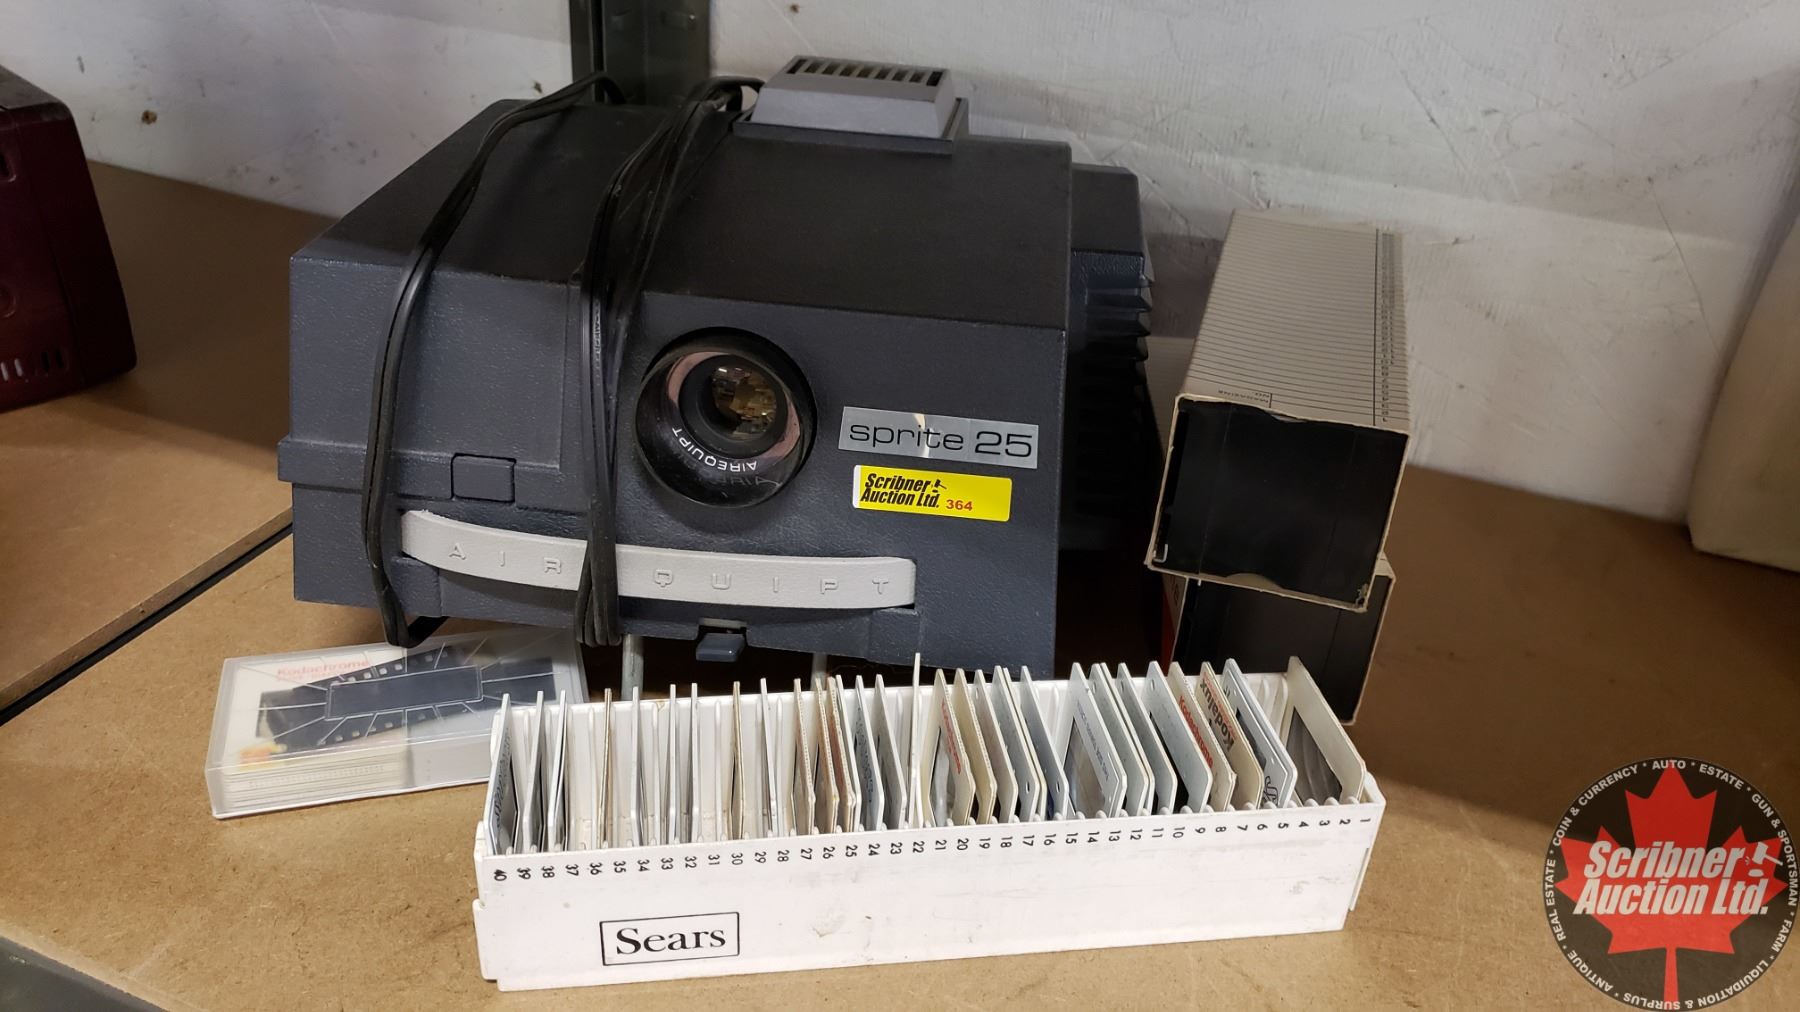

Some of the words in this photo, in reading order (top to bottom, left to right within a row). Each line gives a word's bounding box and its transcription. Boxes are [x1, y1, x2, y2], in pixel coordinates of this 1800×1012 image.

[672, 427, 758, 473] AIREQUIPT
[849, 423, 965, 452] sprite
[974, 430, 1032, 458] 25
[861, 487, 916, 506] Auction
[915, 492, 940, 509] Ltd.
[865, 473, 932, 494] Scribner
[945, 498, 974, 513] 364
[1200, 679, 1235, 752] Kodalux
[494, 869, 507, 881] 40
[517, 867, 531, 879] 39
[541, 865, 555, 878] 38
[565, 864, 579, 876] 37
[587, 862, 603, 875] 36
[613, 861, 626, 873] 35
[637, 859, 650, 872] 34
[660, 858, 674, 870] 33
[684, 856, 697, 868] 32
[708, 854, 720, 865] 31
[731, 853, 743, 865] 30
[755, 851, 767, 863] 29
[777, 850, 790, 862] 28
[801, 848, 813, 860] 27
[822, 846, 835, 859] 26
[845, 845, 858, 857] 25
[868, 843, 880, 856] 24
[890, 842, 903, 855] 23
[912, 841, 925, 853] 22
[935, 840, 947, 850] 21
[957, 838, 969, 850] 20
[979, 837, 991, 849] 19
[1000, 836, 1013, 848] 18
[1022, 835, 1035, 846] 17
[1044, 834, 1056, 846] 16
[1065, 833, 1078, 844] 15
[1086, 831, 1100, 843] 14
[1109, 830, 1121, 841] 13
[1130, 829, 1143, 840] 12
[1152, 828, 1164, 838] 11
[1173, 827, 1185, 838] 10
[615, 927, 727, 956] Sears
